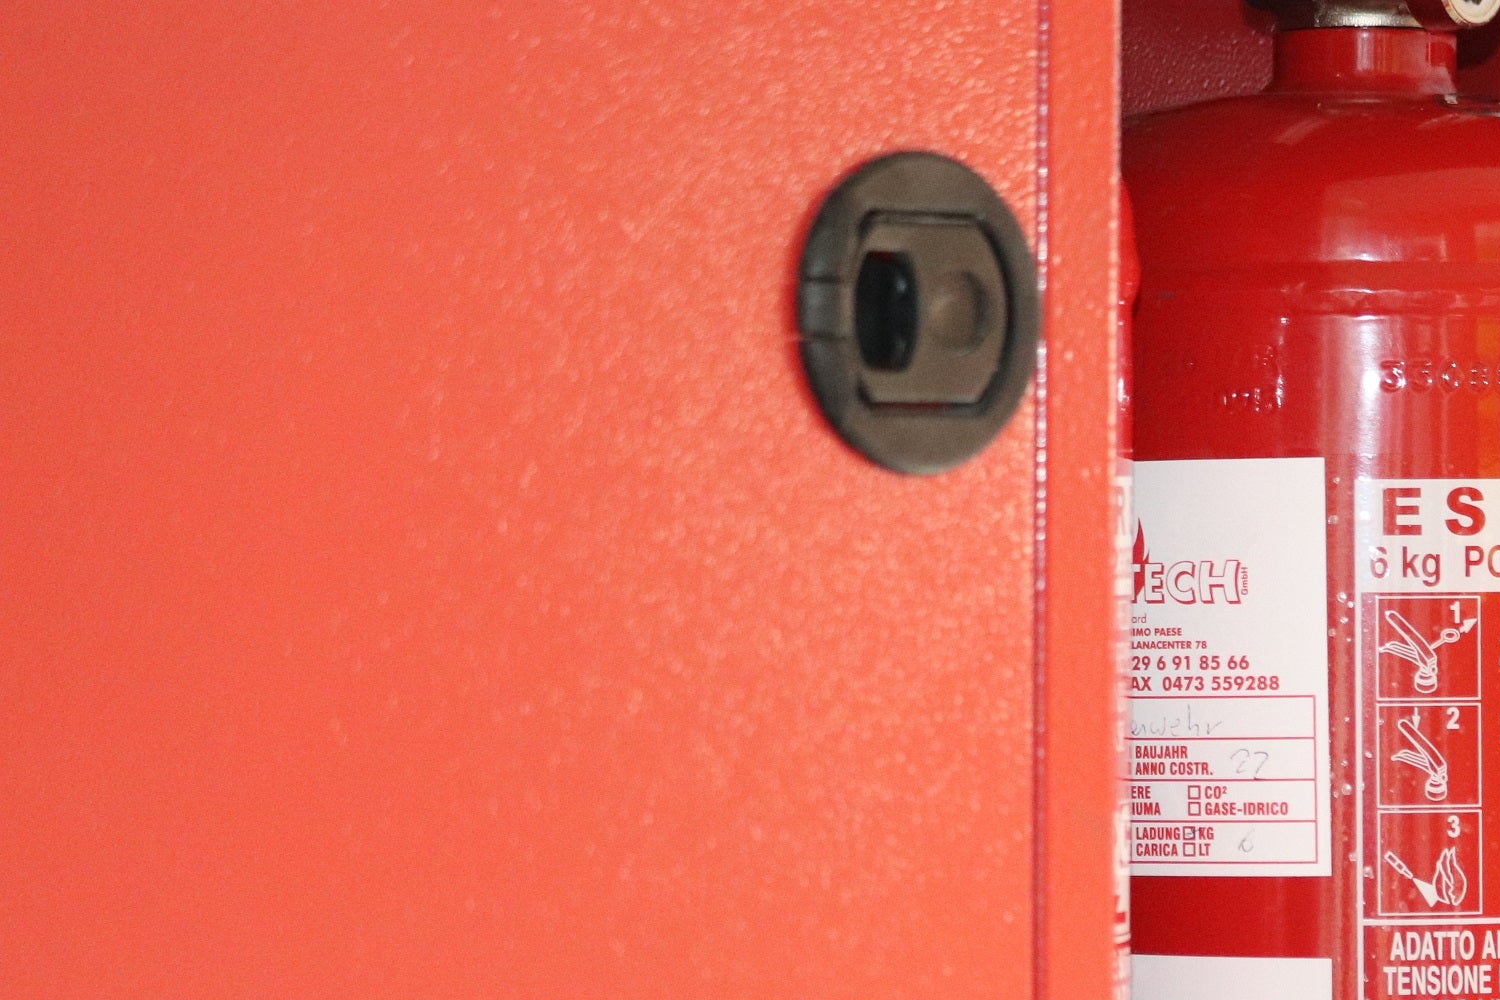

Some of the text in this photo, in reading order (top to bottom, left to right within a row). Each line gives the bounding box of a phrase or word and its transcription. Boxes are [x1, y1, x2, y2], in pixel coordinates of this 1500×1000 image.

[1370, 546, 1390, 579] 6
[1402, 546, 1441, 587] kg
[1241, 567, 1249, 596] GmbH
[1450, 602, 1461, 624] 1
[1155, 627, 1182, 637] PAESE
[1196, 640, 1207, 650] 78
[1157, 655, 1250, 671] 6 91 85 66
[1163, 675, 1280, 692] 0473 559288
[1446, 707, 1460, 729] 2
[1135, 745, 1188, 759] BAUJAHR
[1135, 762, 1213, 776] ANNO COSTR.
[1204, 802, 1288, 816] GASE-IDRICO
[1136, 827, 1180, 841] LADUNG
[1199, 827, 1214, 840] KG
[1447, 815, 1461, 838] 3
[1136, 843, 1178, 857] CARICA
[1199, 844, 1211, 857] LT
[1390, 930, 1475, 961] ADATTO
[1383, 964, 1492, 996] TENSIONE
